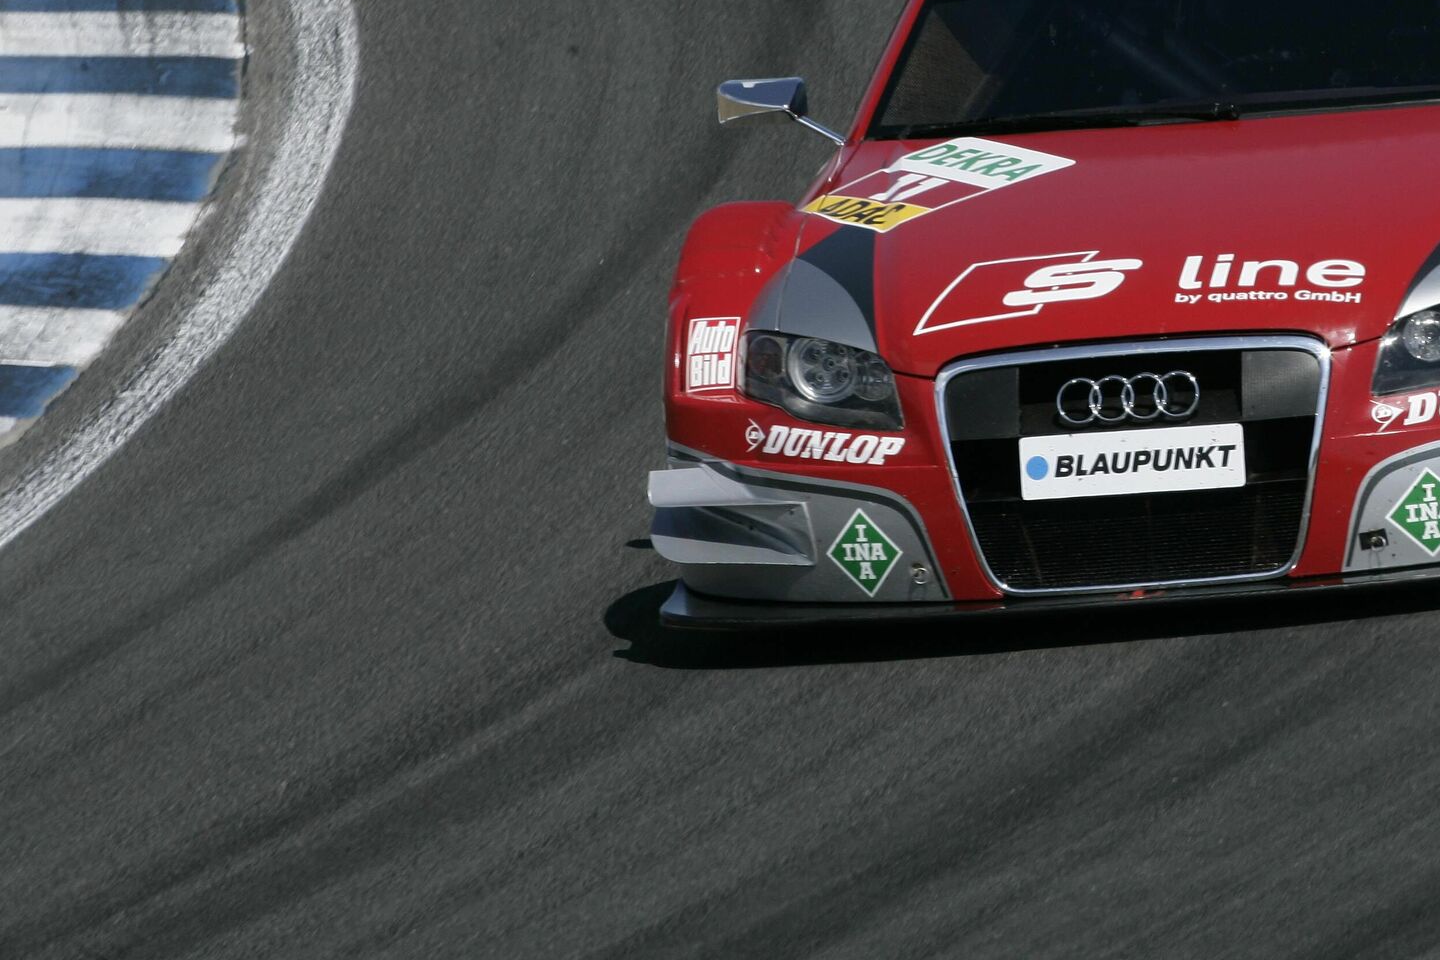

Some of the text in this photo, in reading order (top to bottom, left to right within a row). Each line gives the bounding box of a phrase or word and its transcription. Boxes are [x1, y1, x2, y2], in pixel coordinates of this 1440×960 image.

[904, 143, 1042, 181] DEKRA
[868, 173, 951, 202] 11
[818, 198, 906, 225] ADAC
[1003, 253, 1366, 306] S line
[1175, 289, 1362, 304] by quattro GmbH
[689, 320, 735, 355] Auto
[689, 352, 732, 387] Bild
[762, 425, 905, 465] DUNLOP
[1054, 445, 1236, 478] BLAUPUNKT
[842, 543, 887, 560] INA
